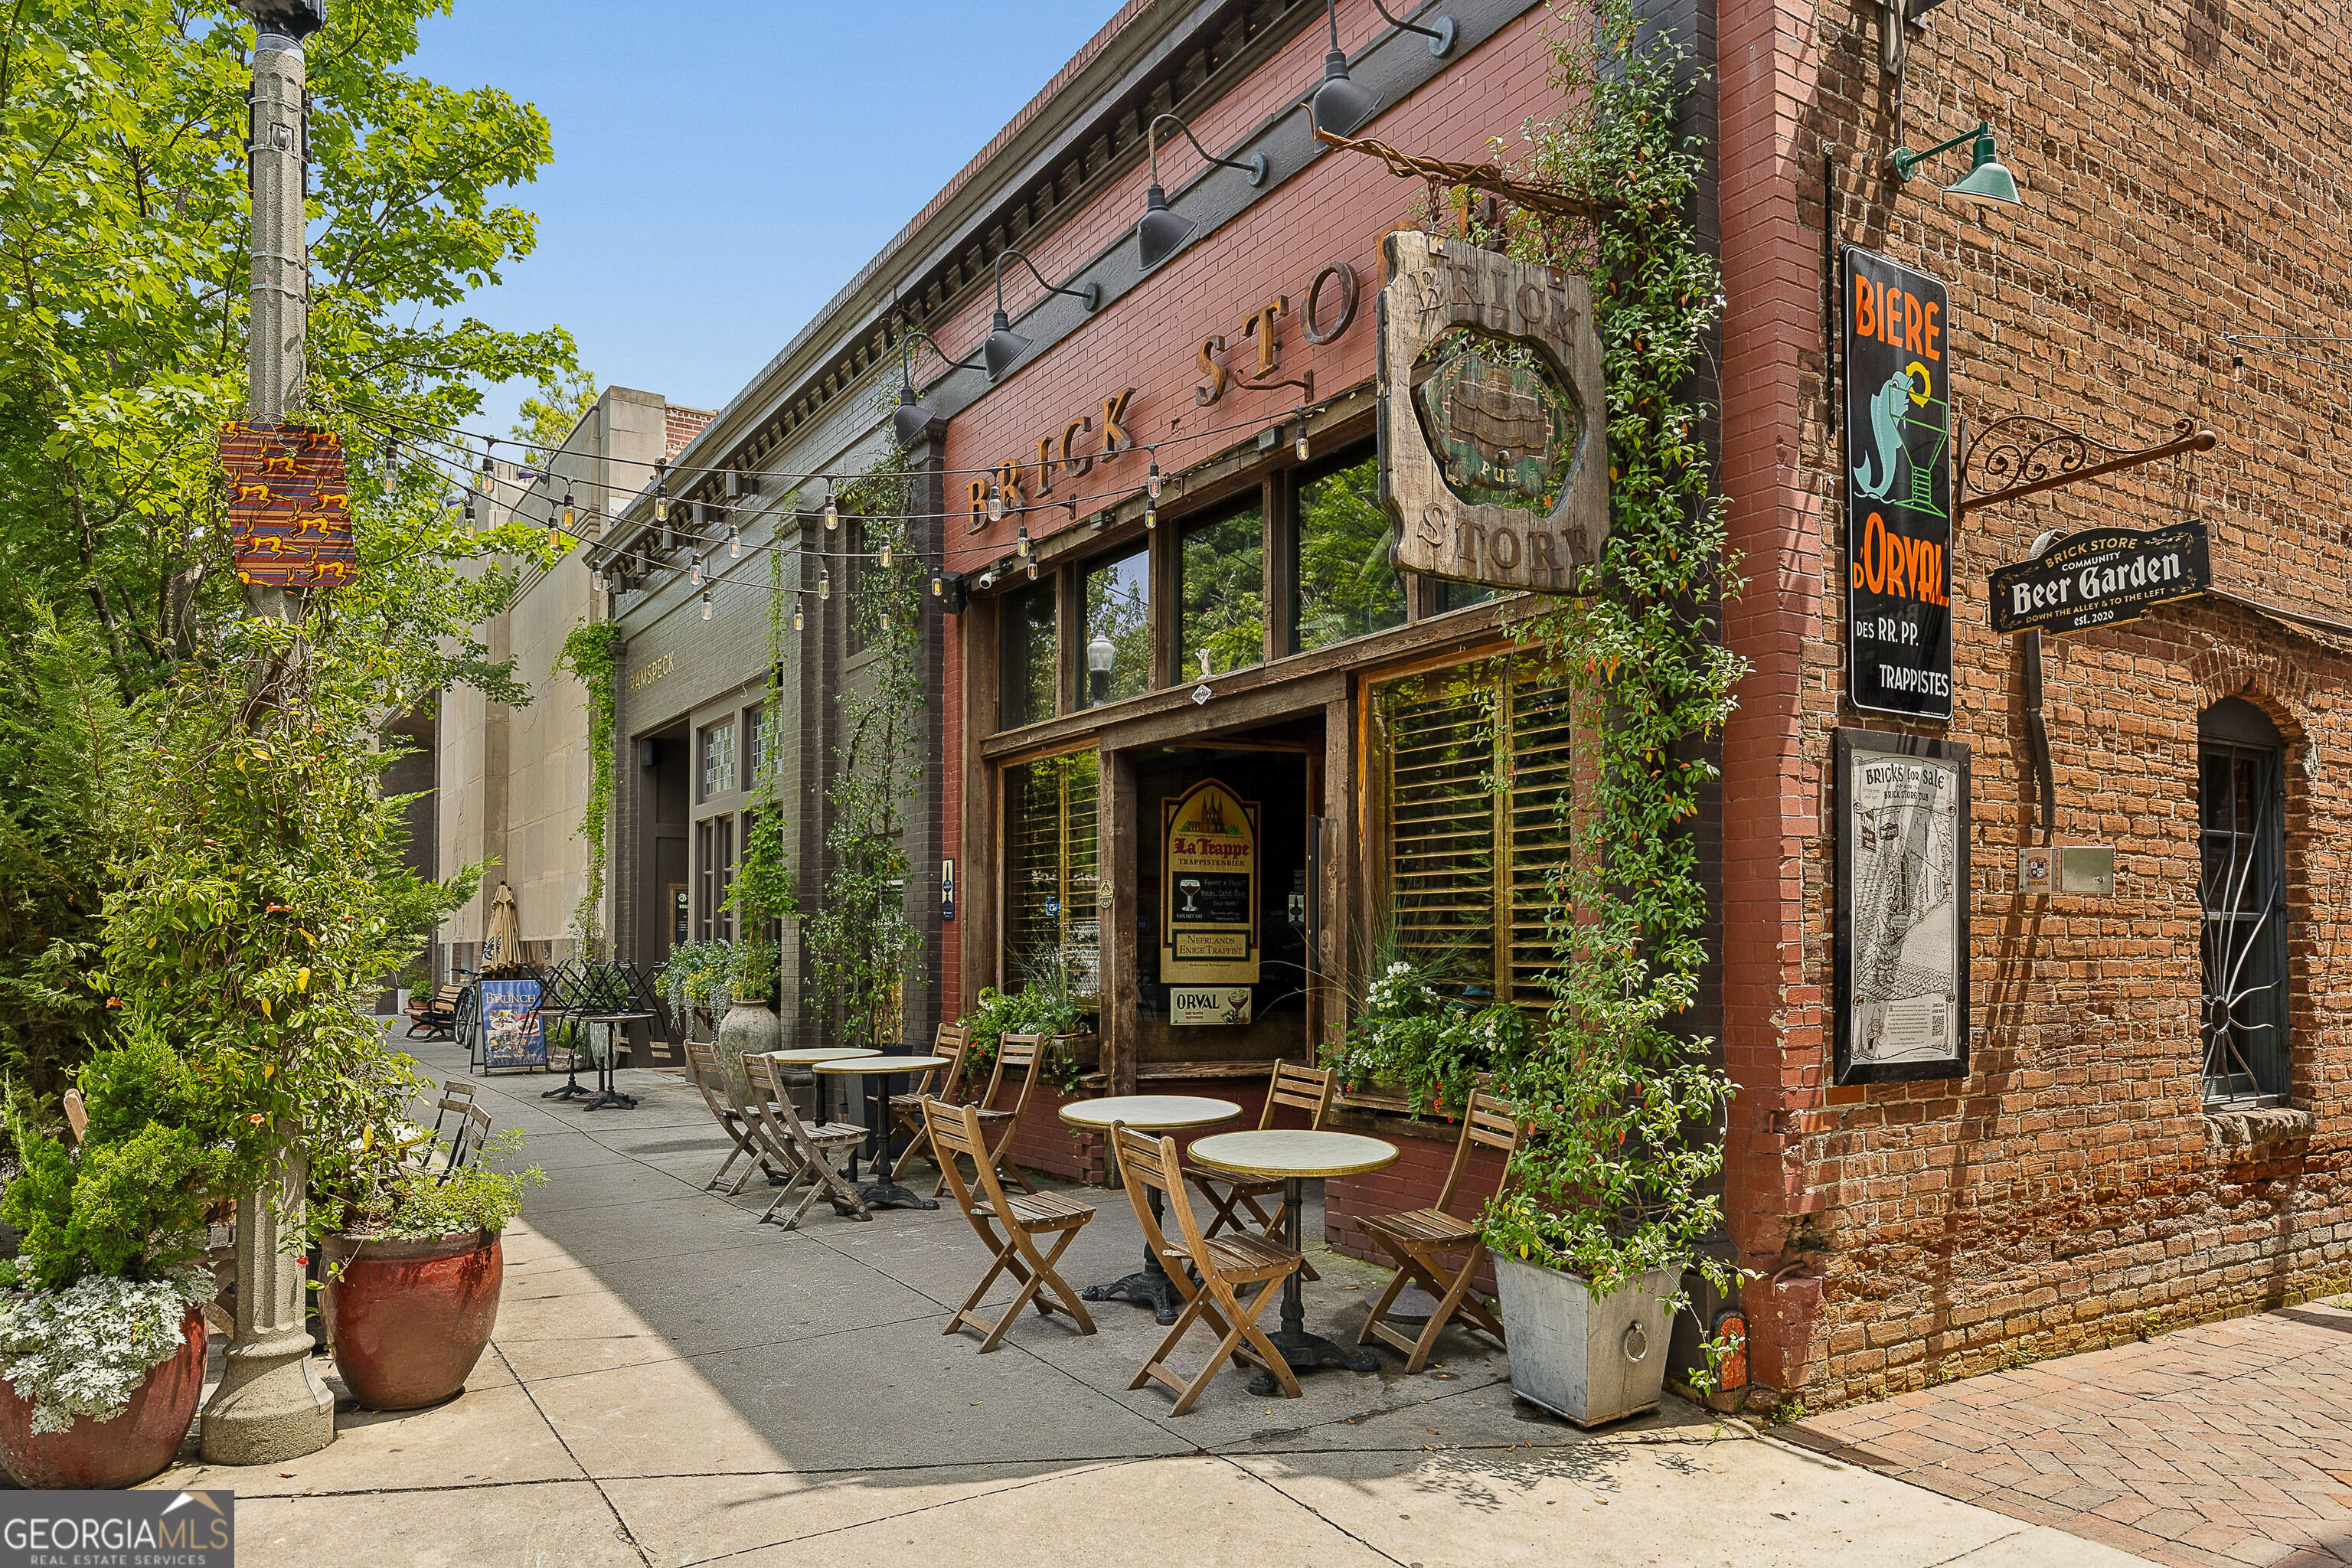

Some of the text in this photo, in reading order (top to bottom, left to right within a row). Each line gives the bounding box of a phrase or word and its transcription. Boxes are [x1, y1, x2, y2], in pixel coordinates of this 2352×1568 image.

[1408, 263, 1581, 347] BRICK
[1855, 273, 1941, 361] BIERE
[966, 387, 1136, 535] BRICK
[1480, 459, 1519, 484] PUB
[1417, 502, 1595, 570] STORE
[2045, 537, 2138, 569] BRICK STORE
[2062, 550, 2121, 571] COMMUNITY
[2011, 552, 2181, 616] Beer Garden
[2026, 612, 2053, 623] DOWN
[2055, 608, 2071, 618] THE
[2073, 602, 2099, 613] ALLEY
[2109, 597, 2122, 607] TO
[2125, 593, 2142, 603] THE
[2145, 587, 2165, 599] LEFT
[2074, 610, 2115, 626] est. 2020
[1857, 617, 1919, 647] DES RR. PP.
[629, 650, 675, 694] RAMSPECK
[1879, 663, 1949, 697] TRAPPISTES
[1173, 838, 1250, 860] La Trappe
[1178, 858, 1245, 867] TRAPPISTENBIER
[1180, 945, 1243, 955] ENIGE TRAPPIST
[1187, 935, 1235, 944] NEERLANDS
[485, 992, 536, 1004] BRUNCH
[1177, 994, 1220, 1009] ORVAL
